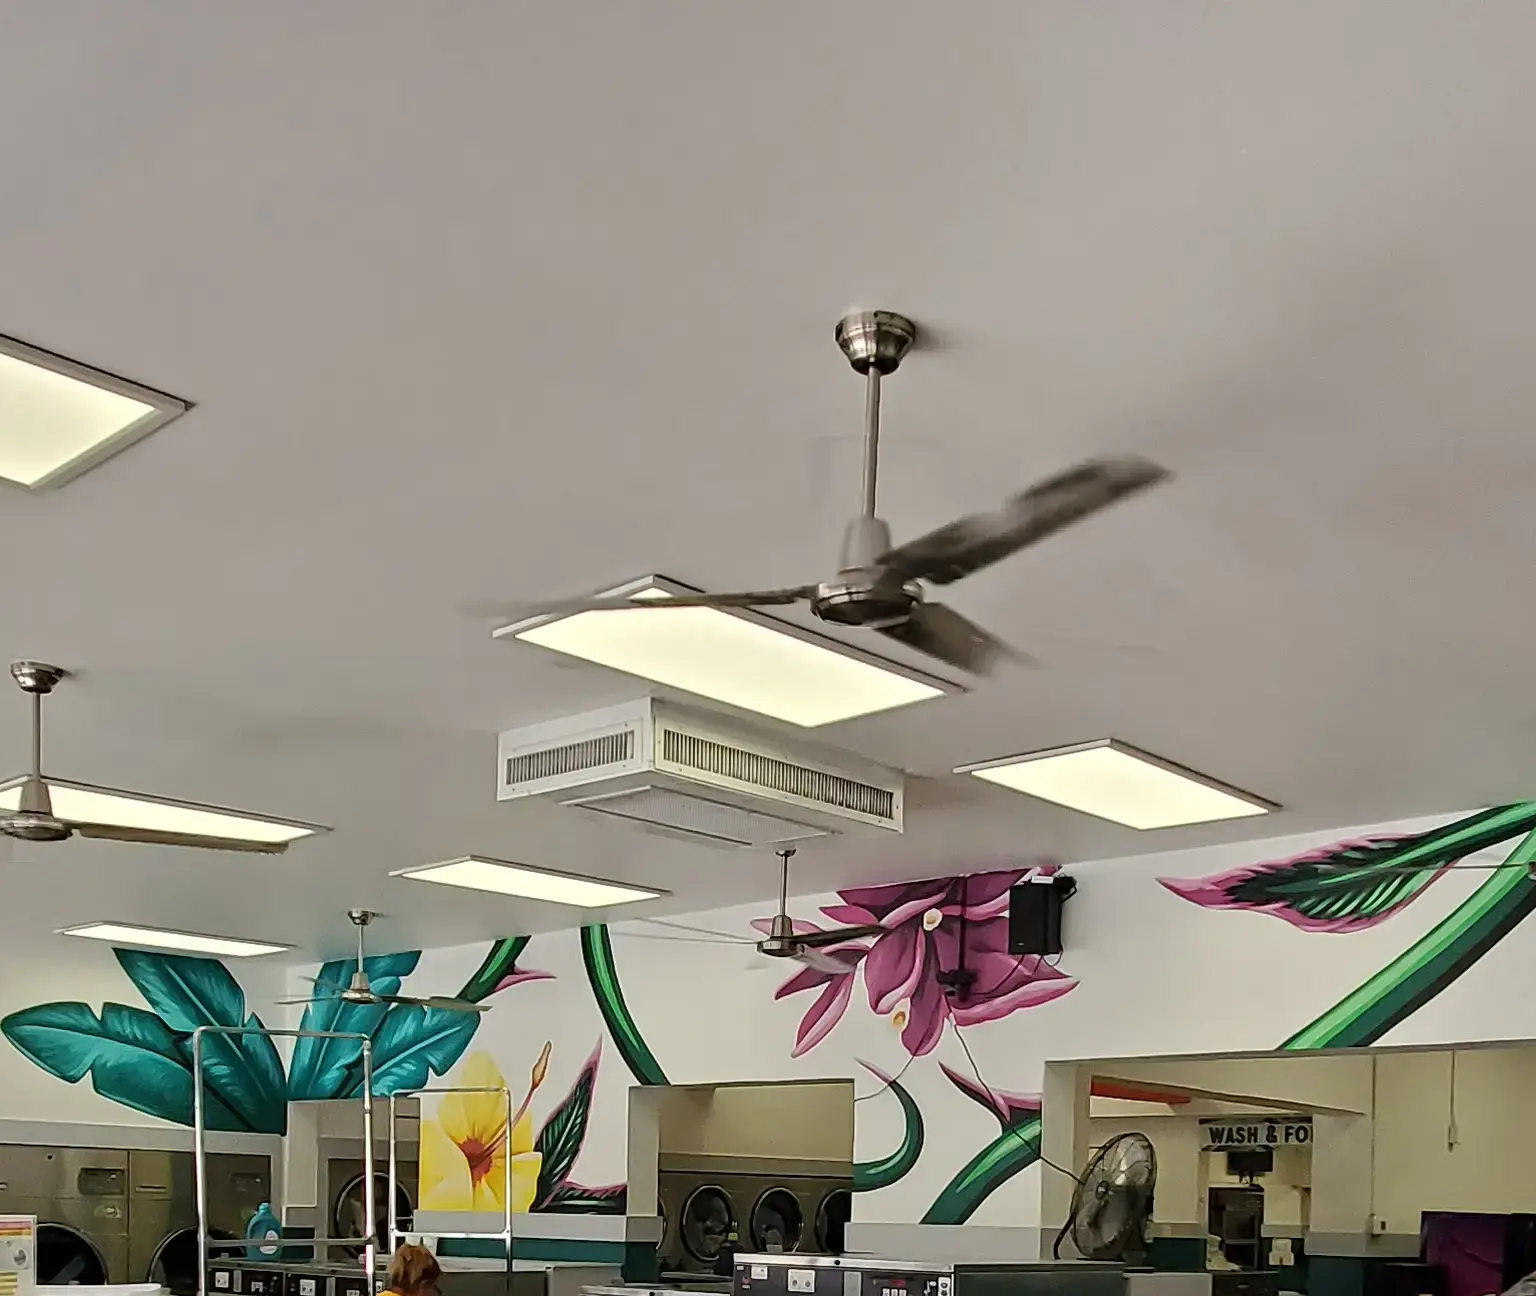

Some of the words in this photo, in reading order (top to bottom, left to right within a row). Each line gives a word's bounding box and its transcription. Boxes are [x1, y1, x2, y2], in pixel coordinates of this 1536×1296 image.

[1208, 1126, 1259, 1144] WASH
[1265, 1125, 1278, 1143] &
[1284, 1125, 1313, 1143] FO
